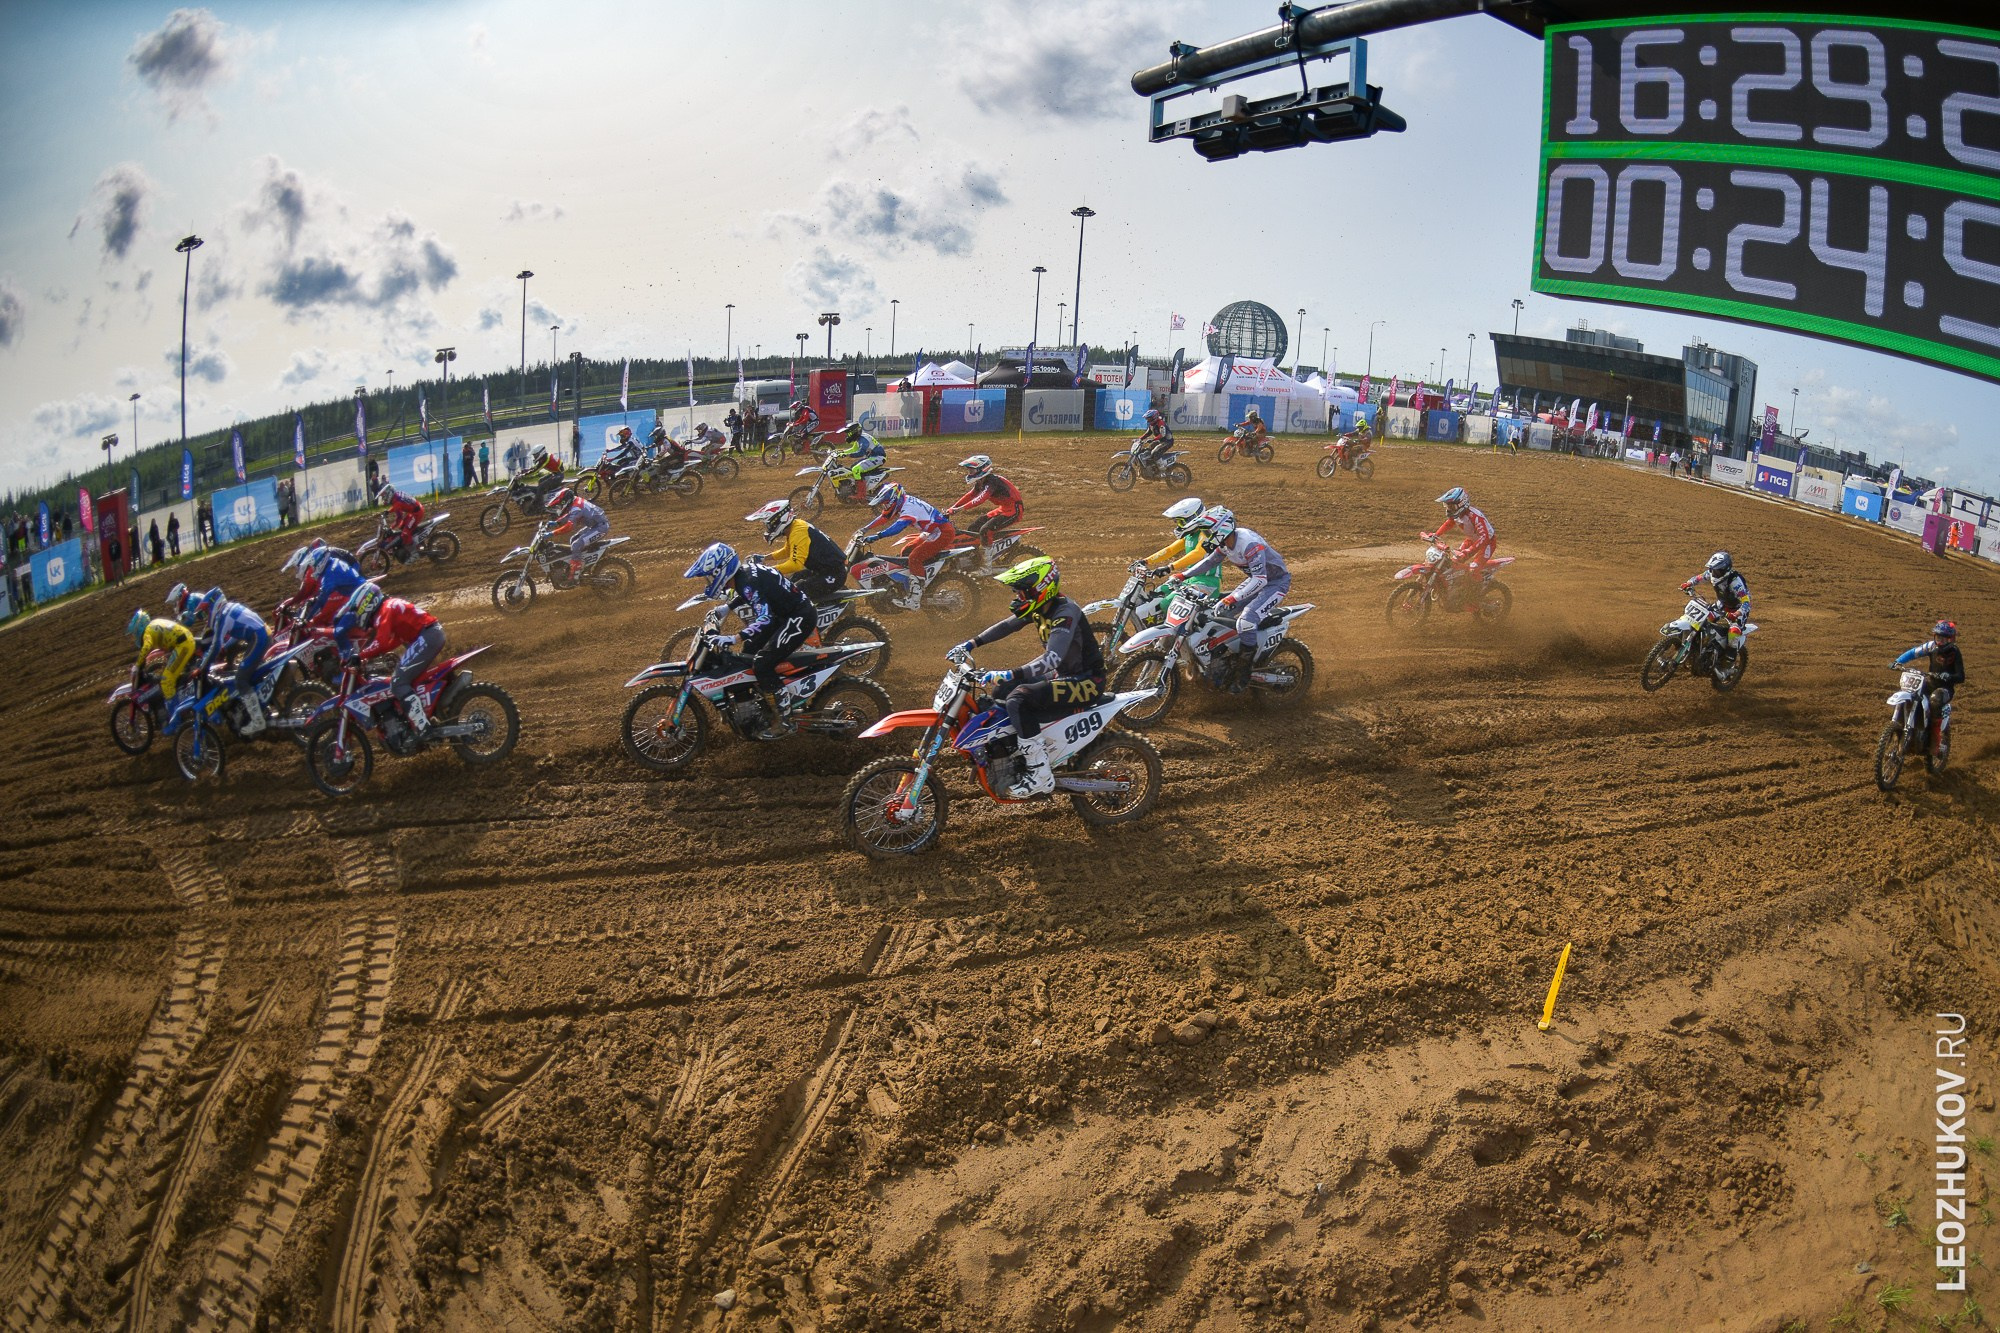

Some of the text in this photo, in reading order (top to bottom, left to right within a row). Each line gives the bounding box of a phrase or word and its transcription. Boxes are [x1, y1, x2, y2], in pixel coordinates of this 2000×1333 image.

[1565, 26, 2000, 171] 16:29:2
[875, 415, 919, 432] ГАЗПРОМ
[1044, 413, 1080, 425] ГАЗПРОМ
[1769, 473, 1788, 487] ПСБ
[818, 611, 840, 627] 700
[1168, 603, 1190, 618] 400
[1030, 650, 1062, 677] FXR
[799, 674, 818, 696] 3
[1051, 679, 1099, 704] FXR
[204, 688, 230, 717] DRC
[1064, 711, 1104, 745] 999
